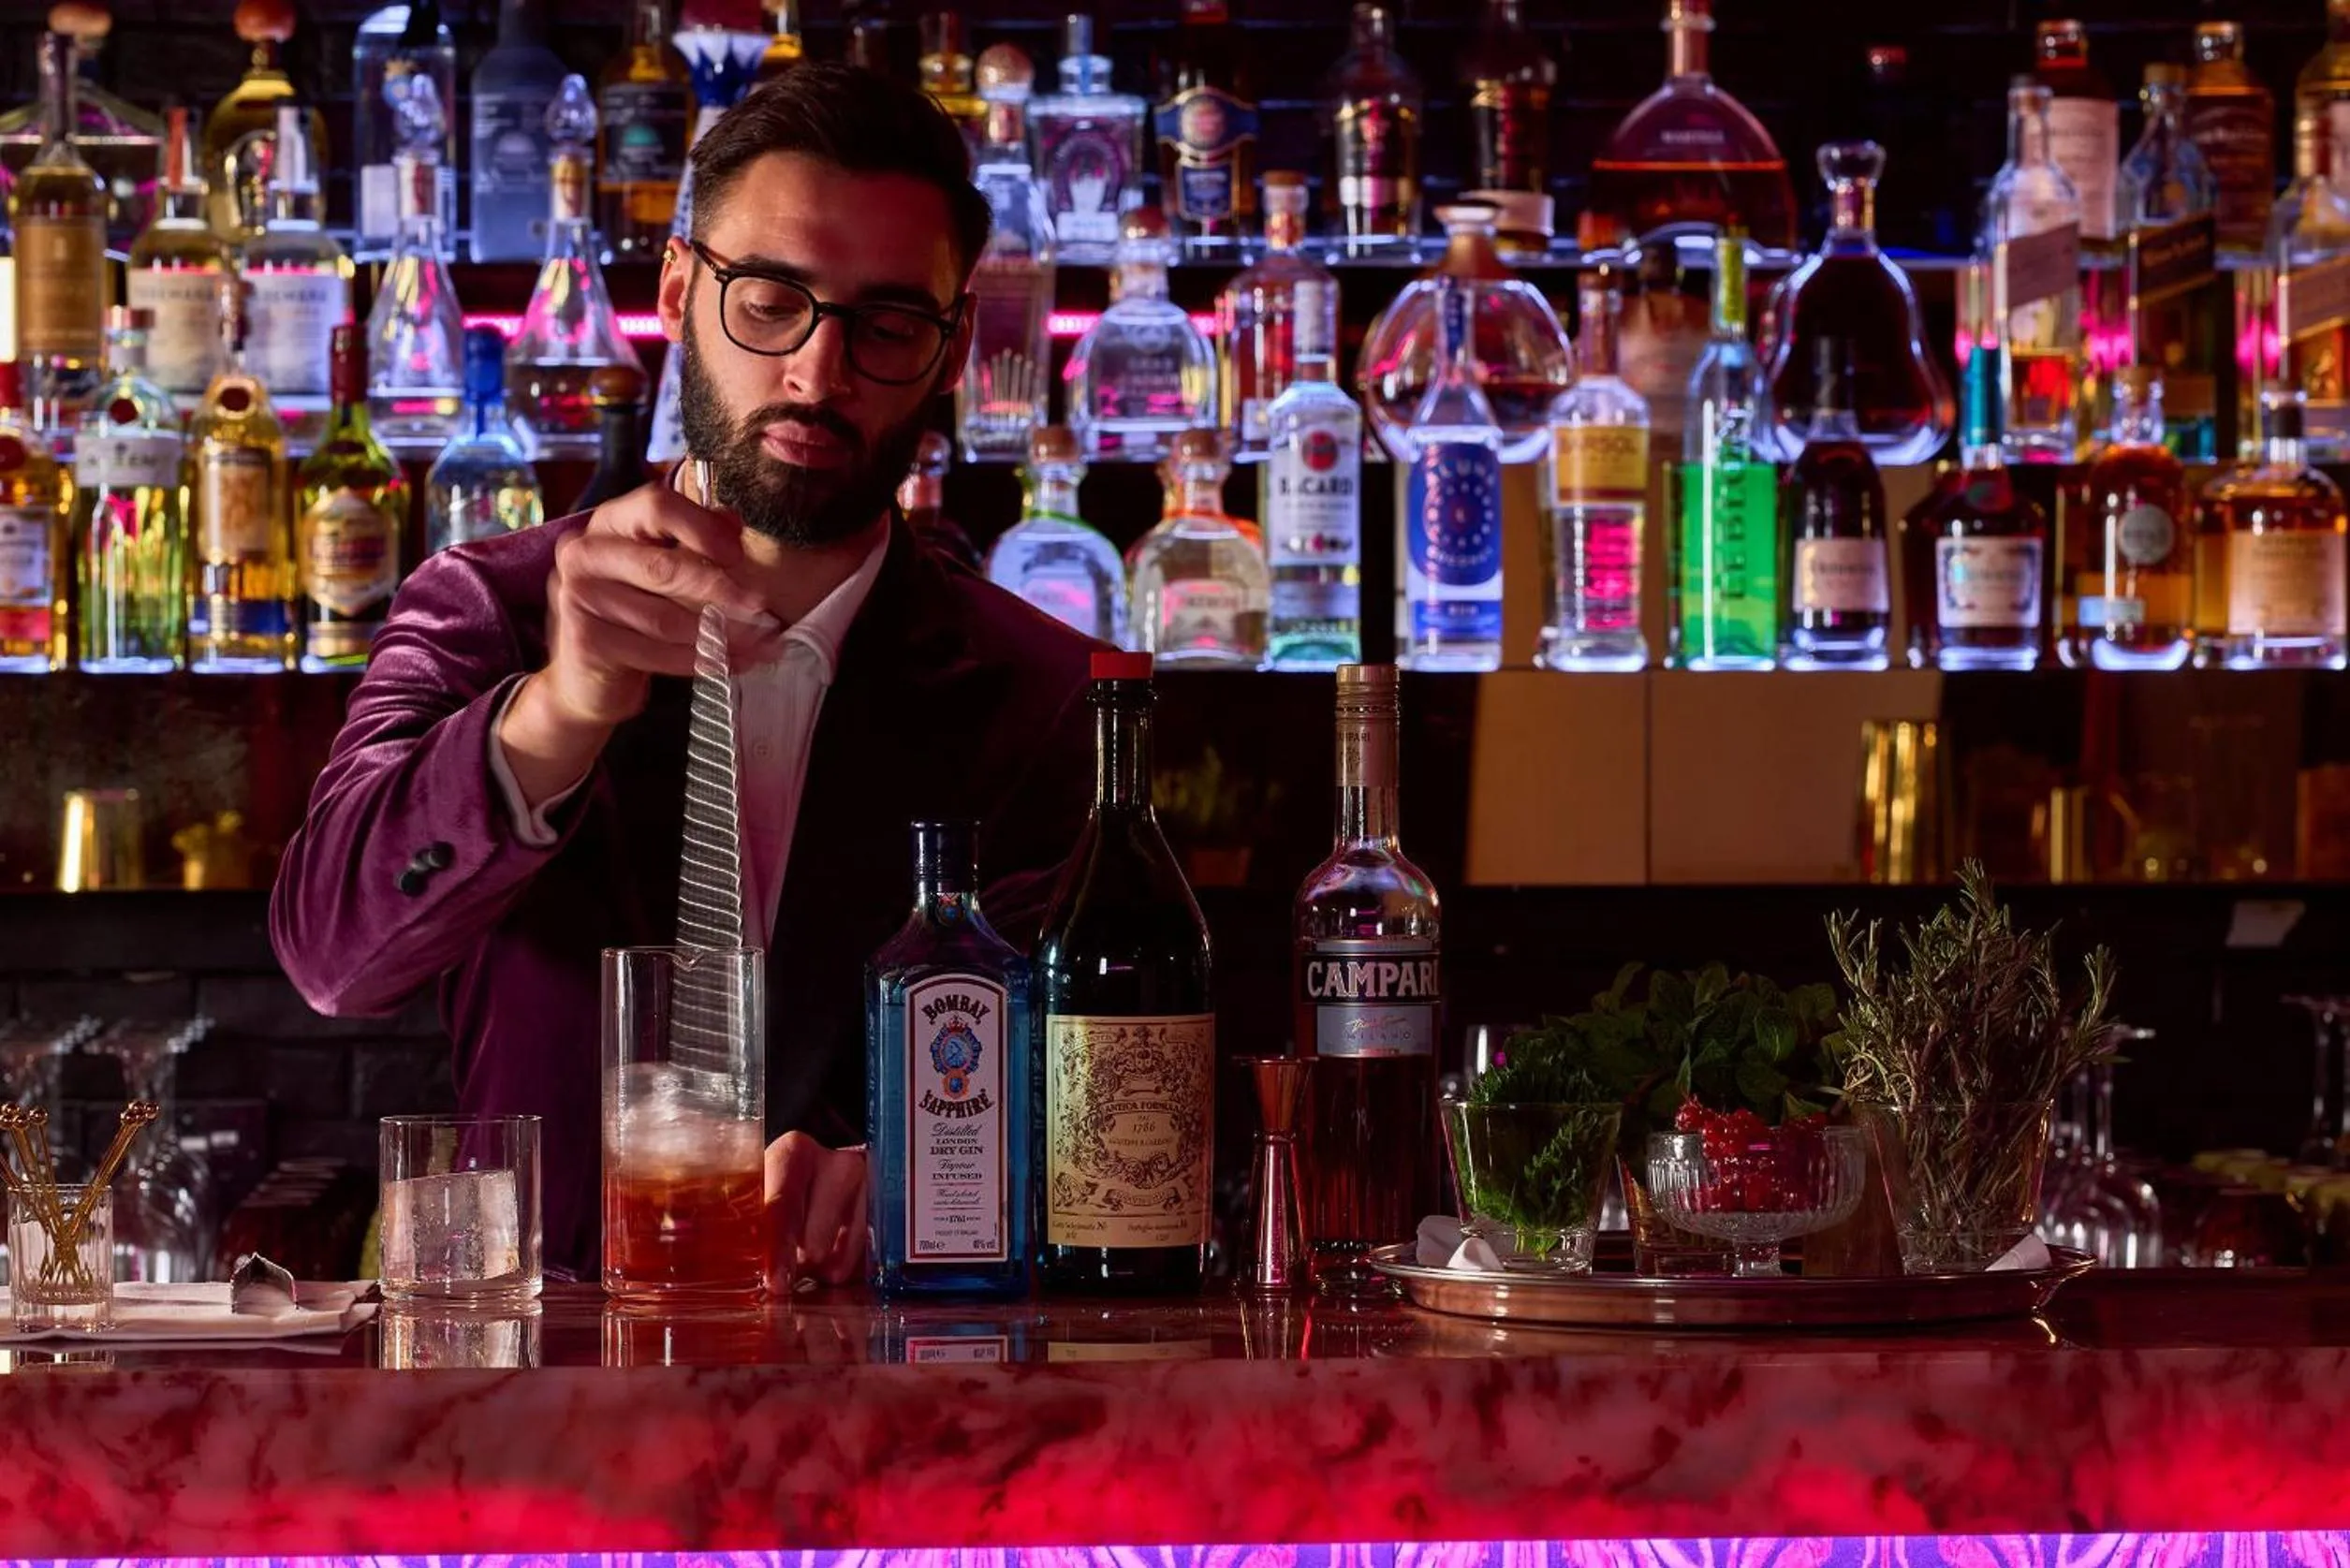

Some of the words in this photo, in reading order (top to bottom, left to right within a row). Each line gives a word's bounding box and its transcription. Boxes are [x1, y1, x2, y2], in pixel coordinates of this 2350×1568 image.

[1307, 960, 1440, 998] CAMPARI
[921, 994, 991, 1025] BOMBAY
[919, 1088, 994, 1119] SAPPHIRE
[931, 1123, 983, 1136] Distilled
[1133, 1123, 1155, 1134] 1786
[930, 1147, 957, 1155] DRY
[959, 1146, 983, 1155] GIN
